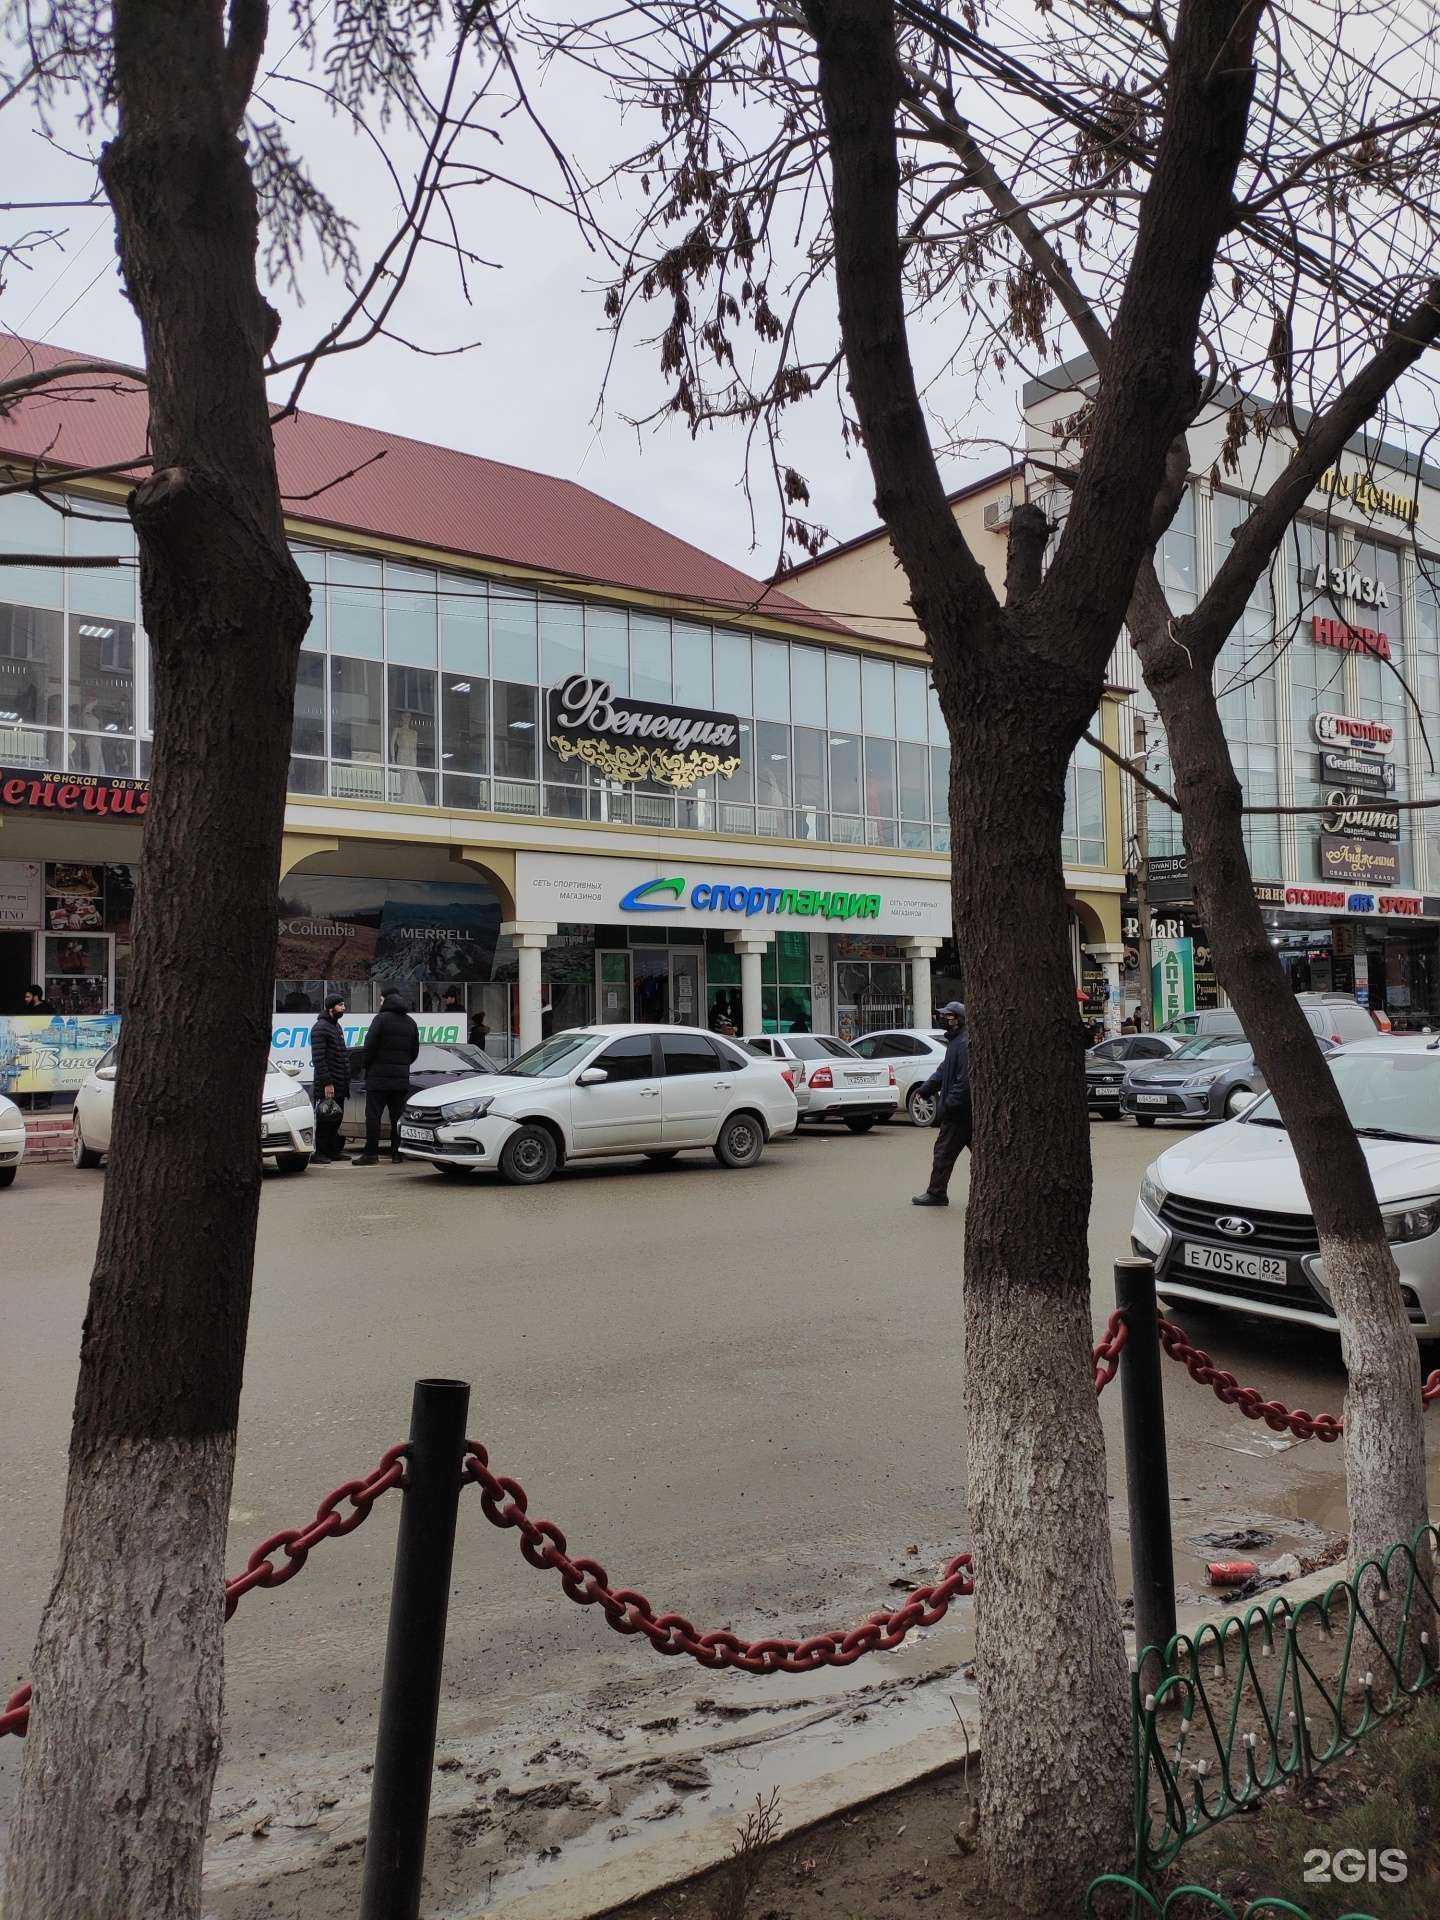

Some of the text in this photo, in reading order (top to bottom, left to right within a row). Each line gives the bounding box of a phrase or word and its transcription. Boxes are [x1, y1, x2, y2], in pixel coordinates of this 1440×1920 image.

[1314, 564, 1390, 608] АЗИЗА
[557, 673, 738, 751] Венеция
[1325, 754, 1382, 776] Gentleman
[42, 773, 151, 791] женская одеж
[532, 879, 602, 890] СЕТЬ СПОРТИВНЫХ
[559, 892, 602, 901] МАГАЗИНОВ
[1378, 896, 1424, 916] SPORT
[288, 921, 356, 937] Columbia
[400, 928, 474, 941] MERRELL
